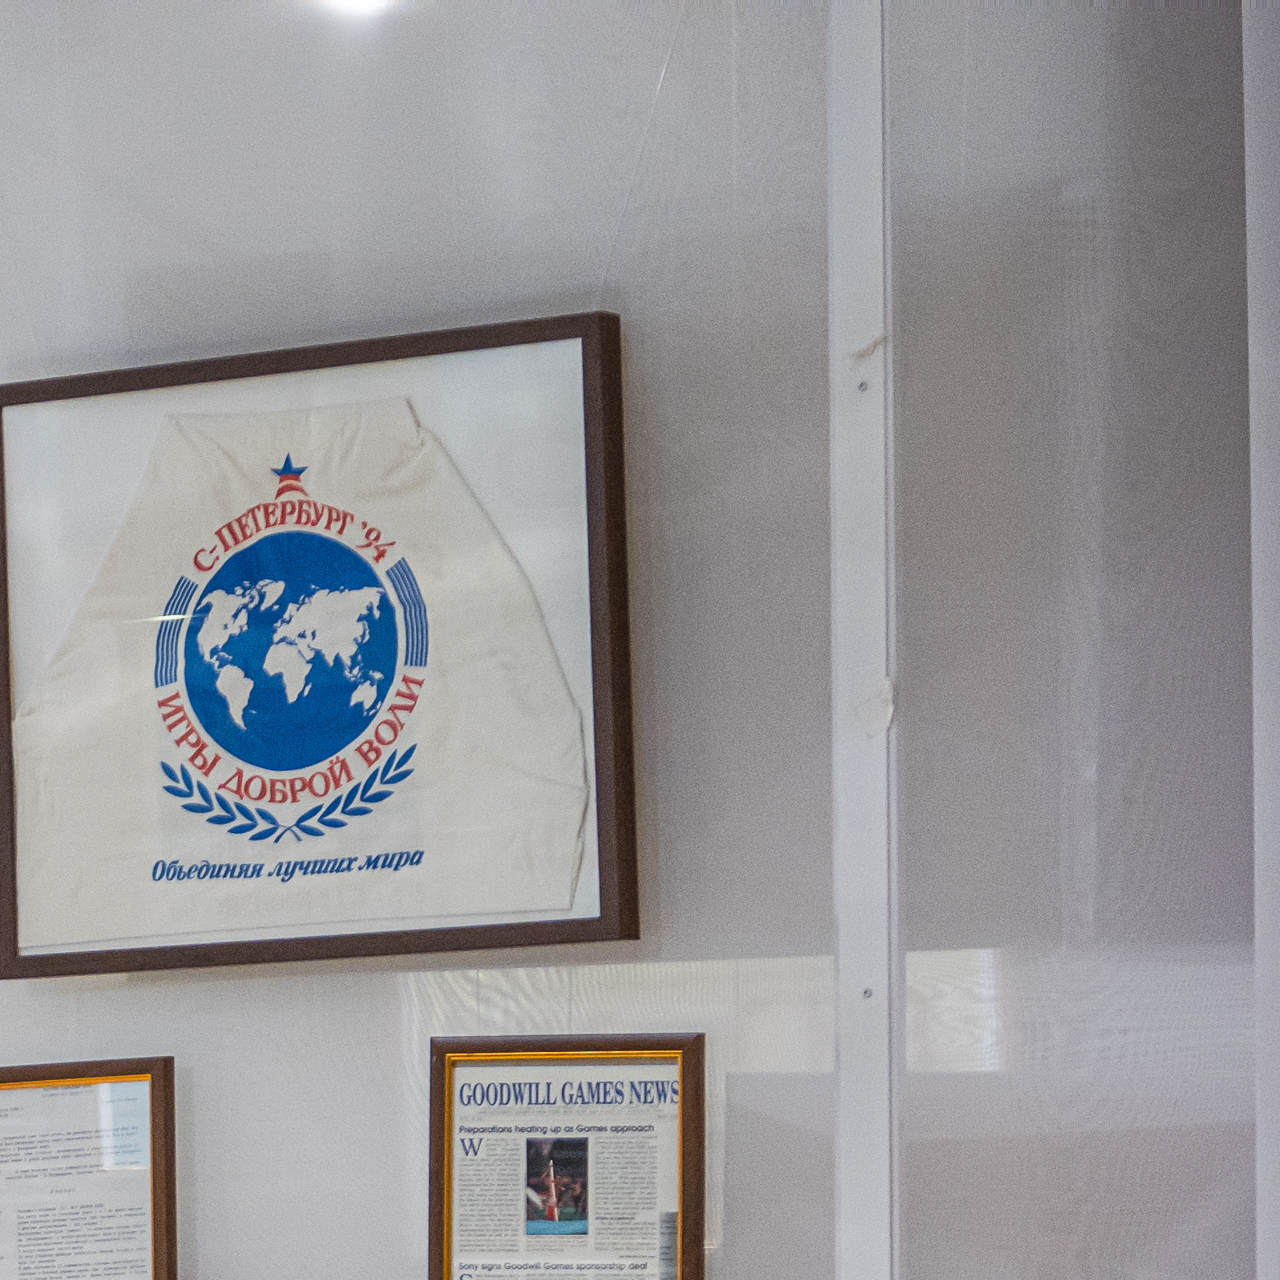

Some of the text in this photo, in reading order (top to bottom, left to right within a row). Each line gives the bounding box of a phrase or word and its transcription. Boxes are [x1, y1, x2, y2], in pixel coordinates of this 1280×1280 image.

[157, 673, 426, 804] ИГРЫ ДОБРОЙ ВОЛИ
[152, 850, 425, 882] Объединяя лучших мира
[459, 1081, 558, 1107] GOODWILL
[561, 1080, 625, 1107] GAMES
[459, 1125, 512, 1136] Preparations
[514, 1125, 548, 1135] heating
[550, 1126, 562, 1134] up
[576, 1124, 607, 1133] Games
[611, 1124, 655, 1134] approach
[460, 1138, 484, 1156] W
[459, 1261, 648, 1271] Sony signs Goodwill Games sponsorship deal
